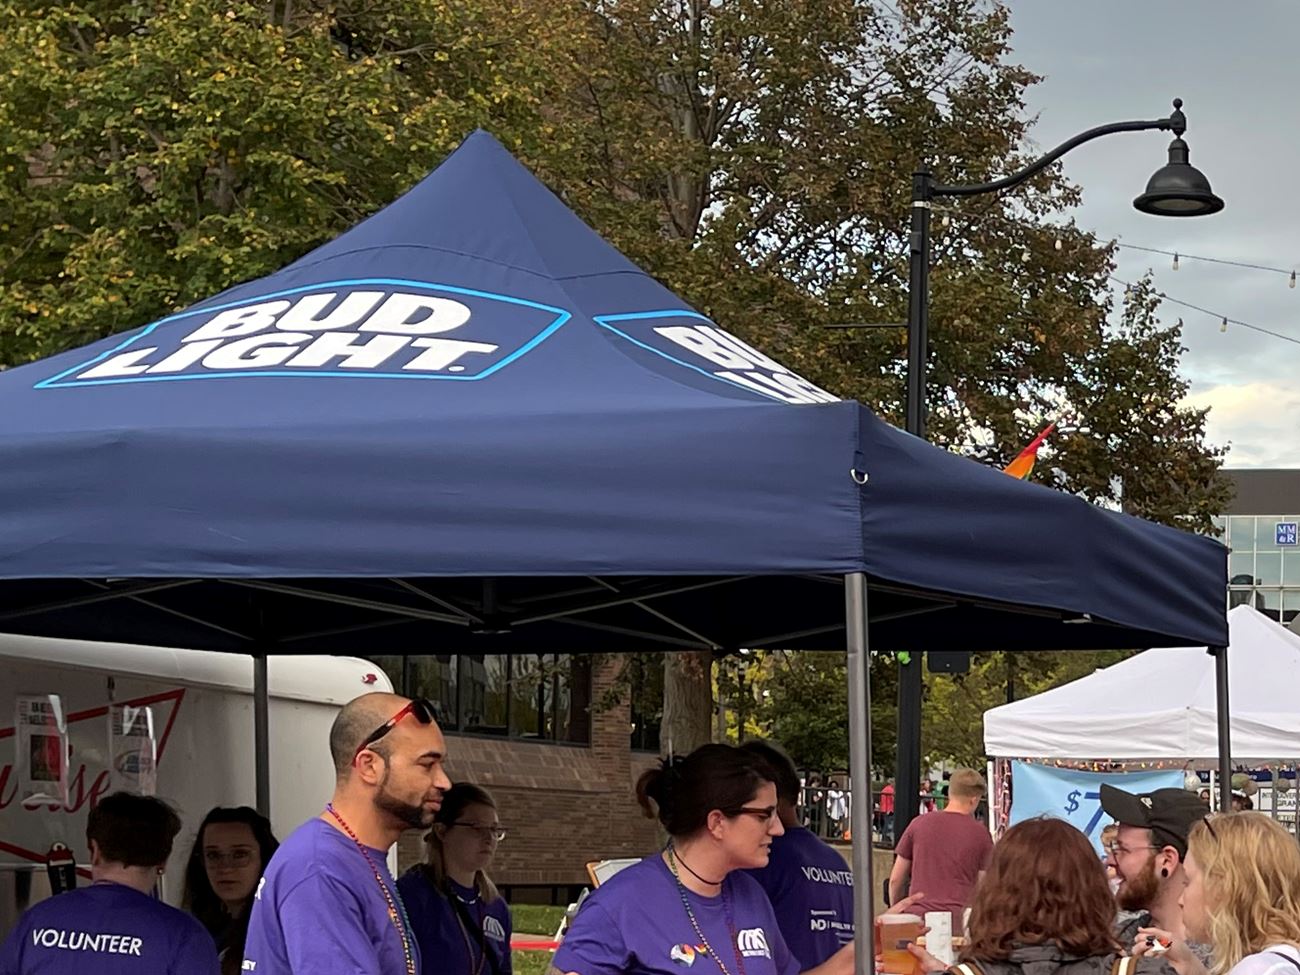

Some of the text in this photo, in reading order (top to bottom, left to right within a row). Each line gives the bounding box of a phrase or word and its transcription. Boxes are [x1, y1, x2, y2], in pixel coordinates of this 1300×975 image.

[181, 291, 472, 343] BUD
[653, 325, 803, 380] BU
[32, 928, 143, 956] VOLUNTEER
